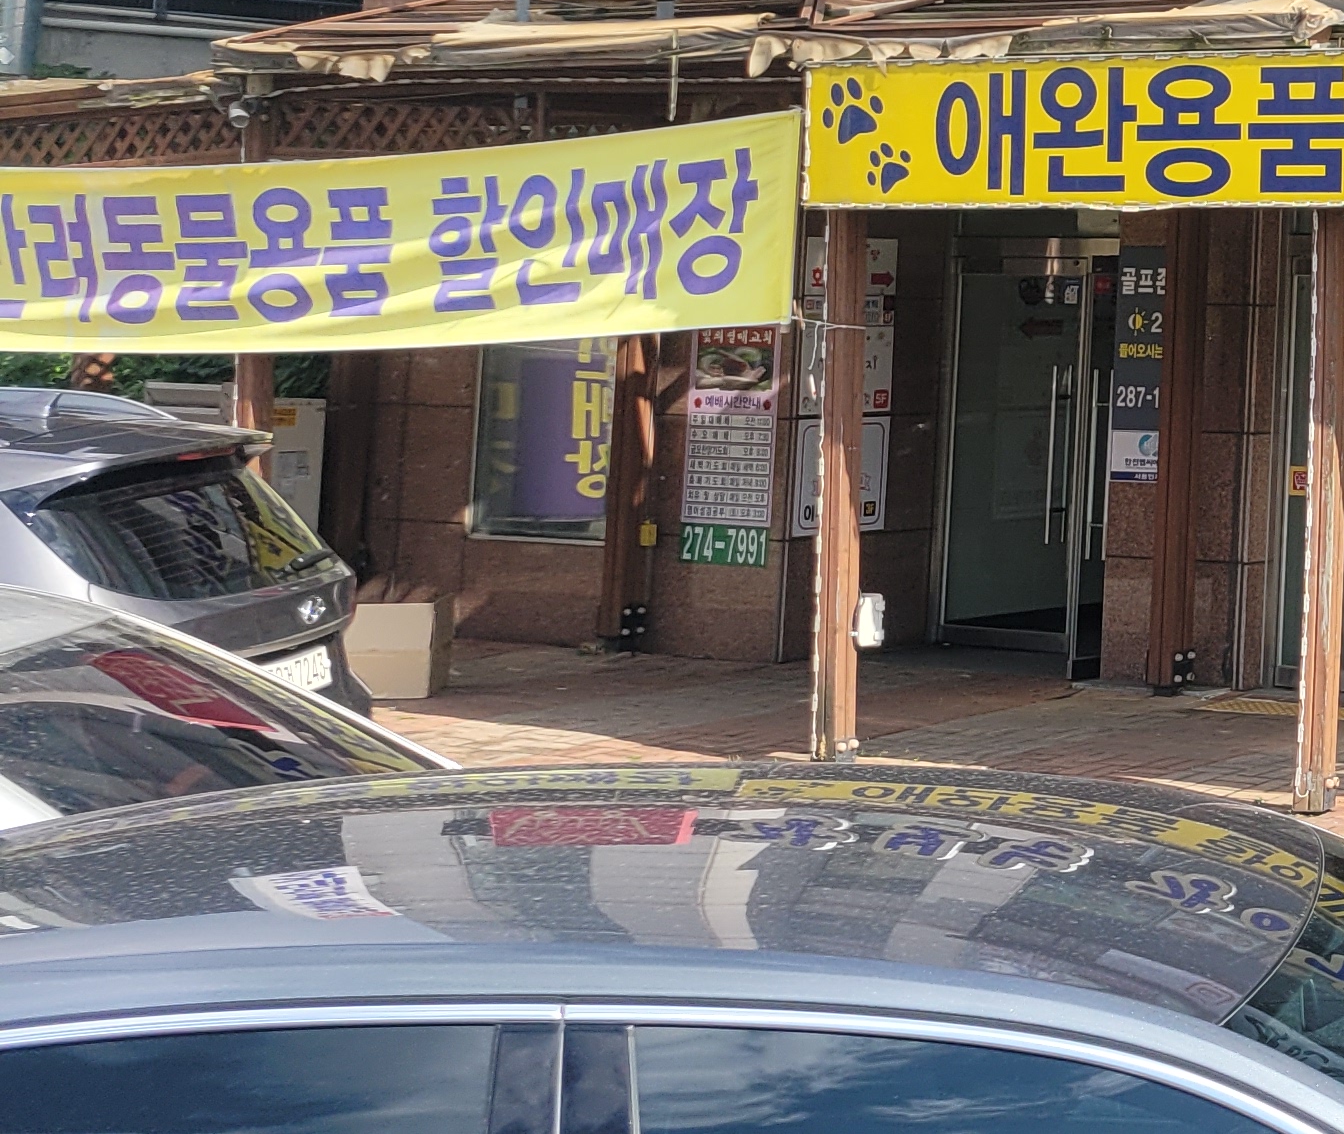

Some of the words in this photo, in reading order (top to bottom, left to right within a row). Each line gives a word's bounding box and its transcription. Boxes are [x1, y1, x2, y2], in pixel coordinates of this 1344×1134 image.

[432, 147, 759, 312] 할인매장
[704, 395, 761, 409] 예배시간안내
[876, 392, 888, 405] 5F
[682, 525, 767, 565] 274-7991
